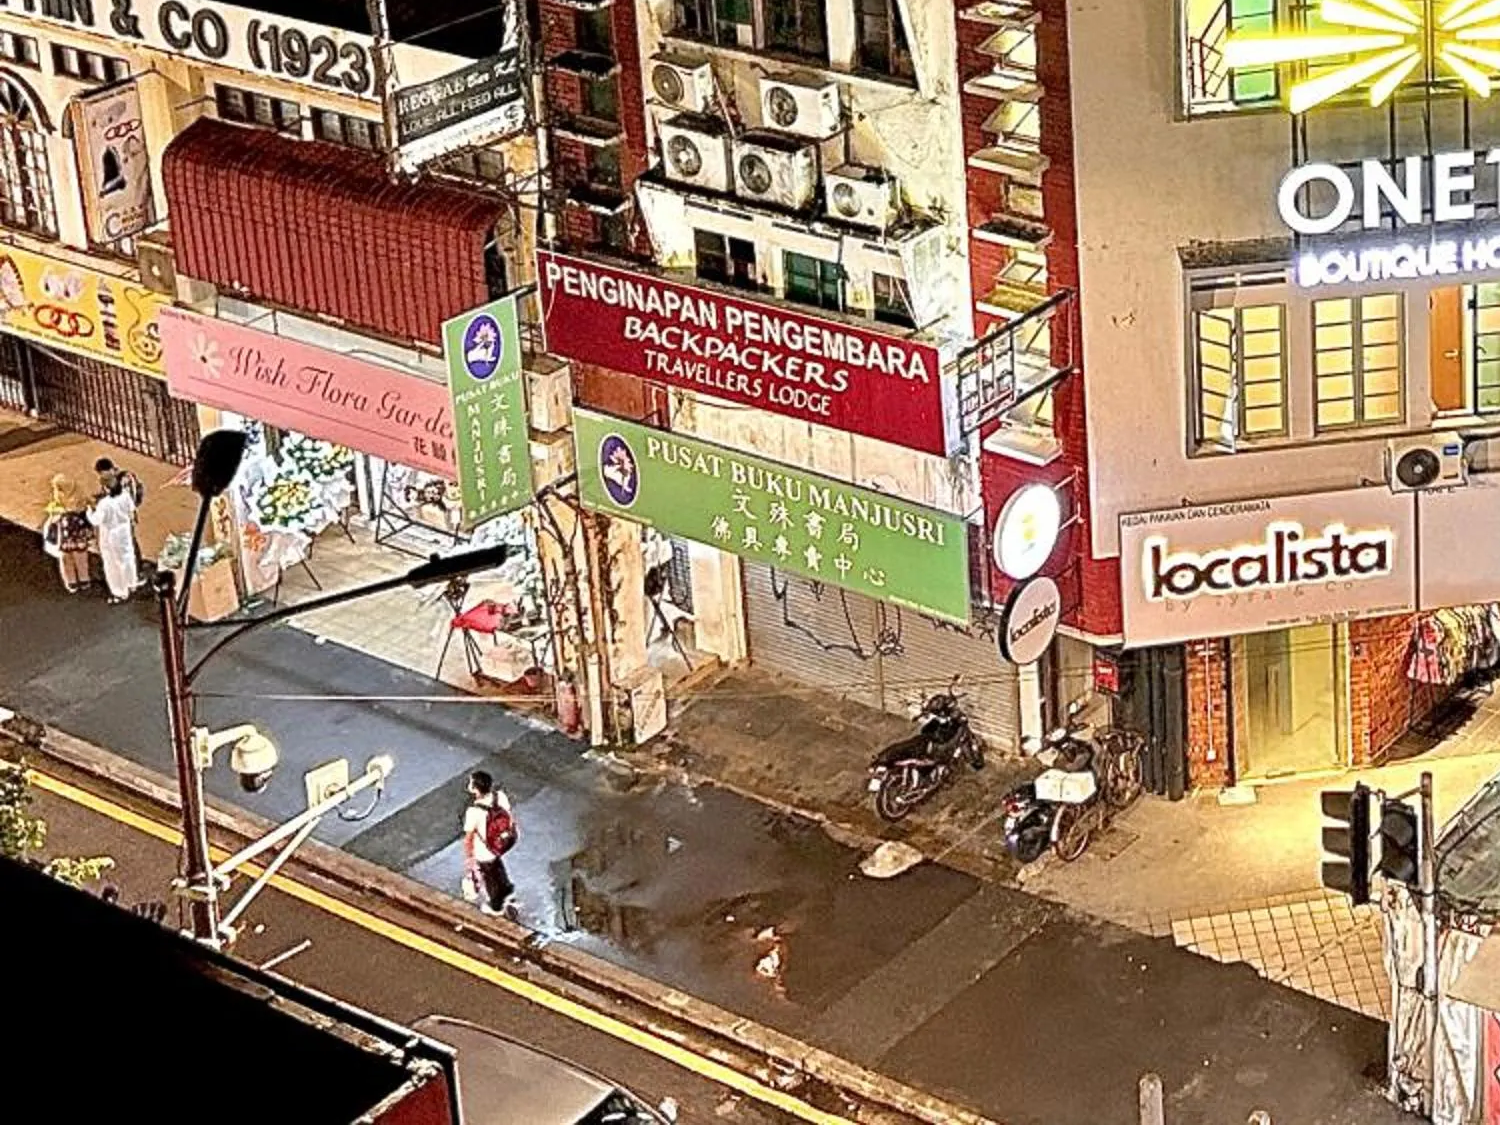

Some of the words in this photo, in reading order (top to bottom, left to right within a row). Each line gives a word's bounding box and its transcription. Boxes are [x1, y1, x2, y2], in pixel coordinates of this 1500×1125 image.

[157, 0, 230, 59] CO
[1298, 238, 1459, 287] BOUTIQUE
[545, 261, 718, 331] PENGINAPAN
[725, 305, 931, 384] PENGEMBARA
[623, 315, 850, 393] BACKPACKERS
[228, 345, 290, 388] Wish
[297, 364, 368, 412] Flora
[376, 389, 454, 439] Garde
[644, 348, 764, 399] TRAVELLERS
[769, 383, 832, 417] LODGE
[467, 402, 487, 503] MANJUSRI
[647, 435, 725, 479] PUSAT
[729, 459, 802, 504] BUKU
[808, 482, 946, 548] MANJUSRI
[1151, 529, 1388, 599] localista
